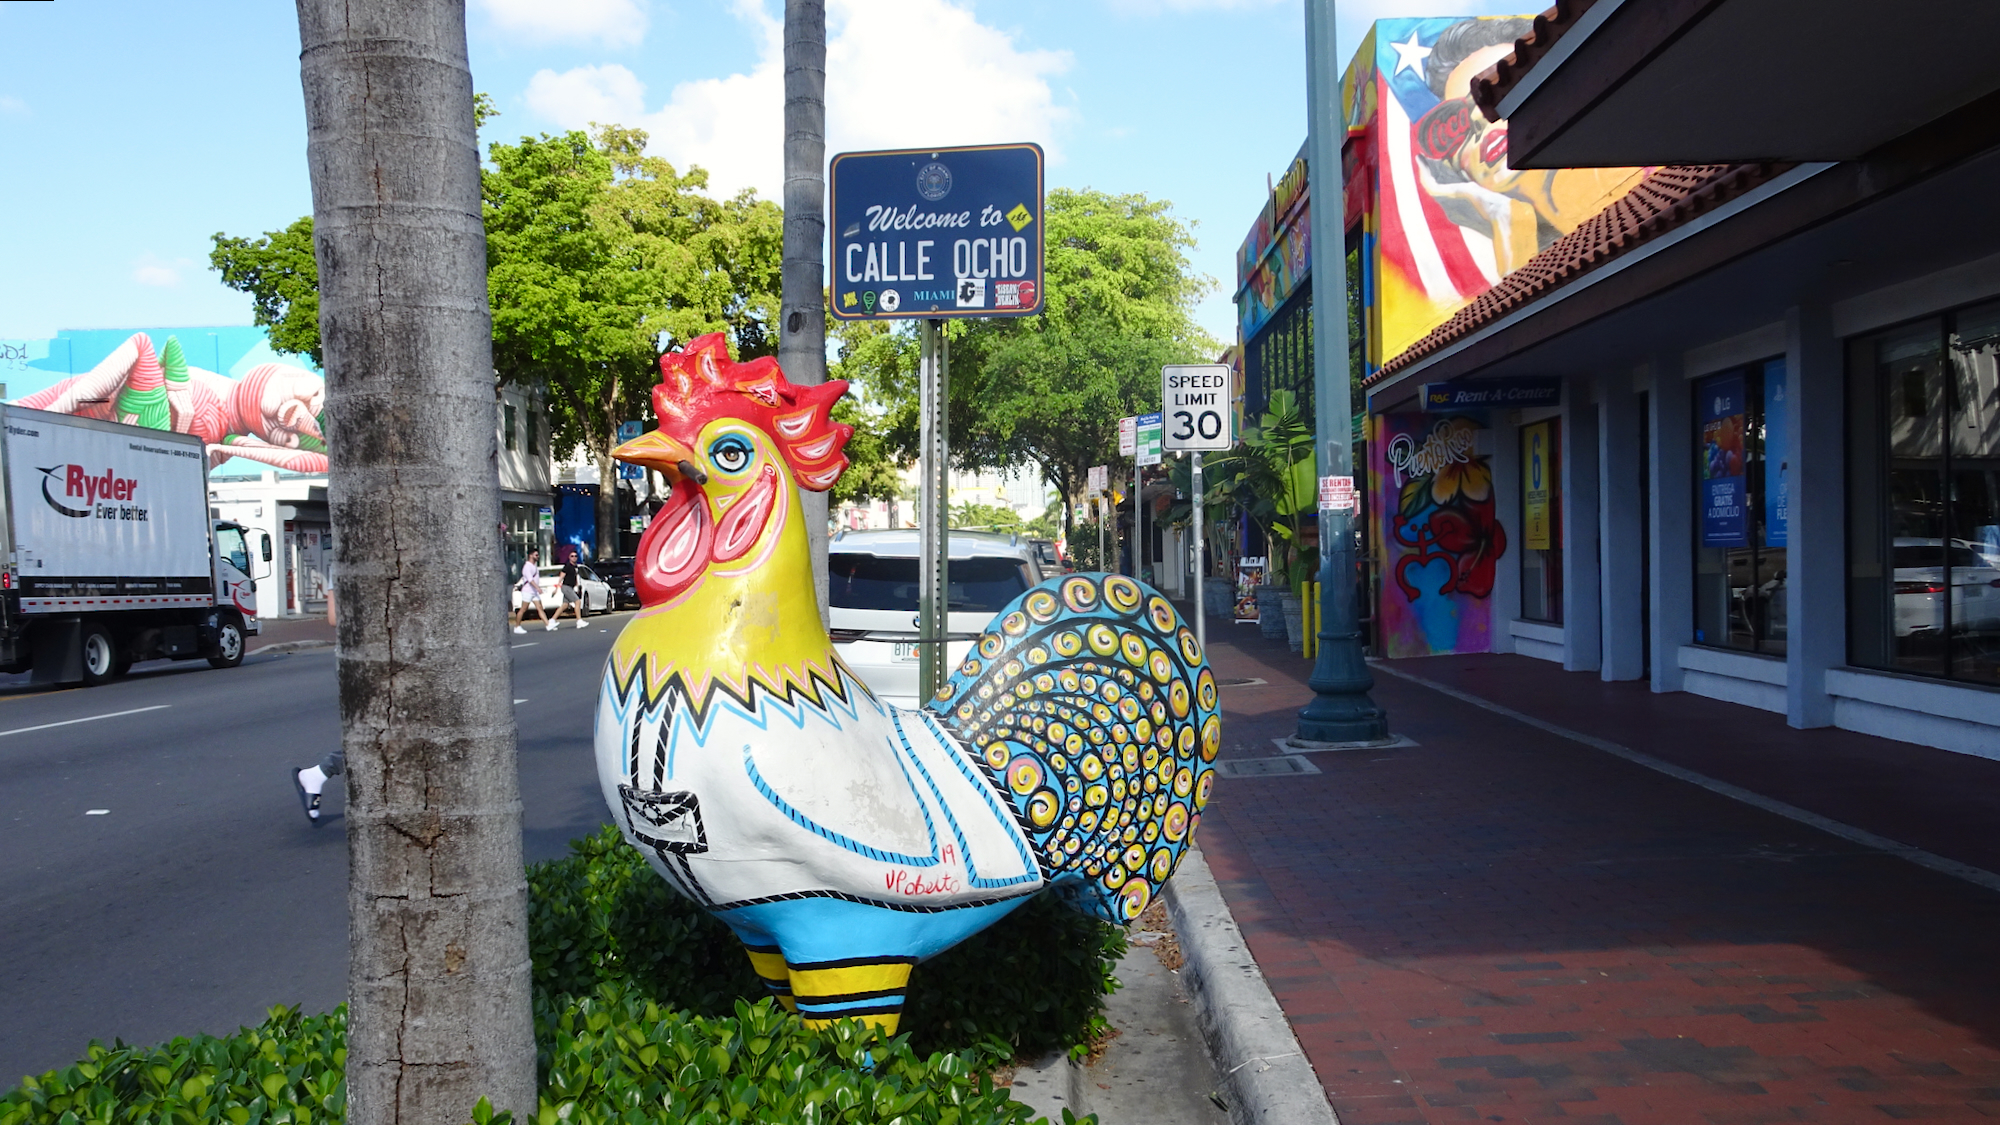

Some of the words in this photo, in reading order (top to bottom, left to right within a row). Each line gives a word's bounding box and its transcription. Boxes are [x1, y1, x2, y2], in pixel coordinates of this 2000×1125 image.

[1427, 107, 1470, 159] Coca
[924, 190, 946, 198] FLORIDA
[865, 203, 970, 232] Welcome
[980, 203, 1003, 228] to
[846, 240, 934, 282] CALLE
[954, 236, 1027, 278] OCHO
[913, 290, 954, 301] MIAMI
[1168, 375, 1224, 388] SPEED
[1175, 393, 1218, 405] LIMIT
[1430, 393, 1450, 403] RAC
[1722, 397, 1731, 411] LG
[8, 424, 40, 438] Ryder.com
[1172, 410, 1222, 440] 30
[1388, 432, 1446, 489] Puerto
[1433, 418, 1473, 464] Rico
[1532, 432, 1541, 490] 6
[66, 463, 138, 507] Ryder
[1712, 484, 1735, 496] ENTREGA
[1714, 495, 1733, 507] GRATIS
[96, 503, 118, 520] Ever
[119, 504, 148, 522] better.
[1712, 506, 1740, 518] DOMICILIO
[942, 843, 956, 867] 19
